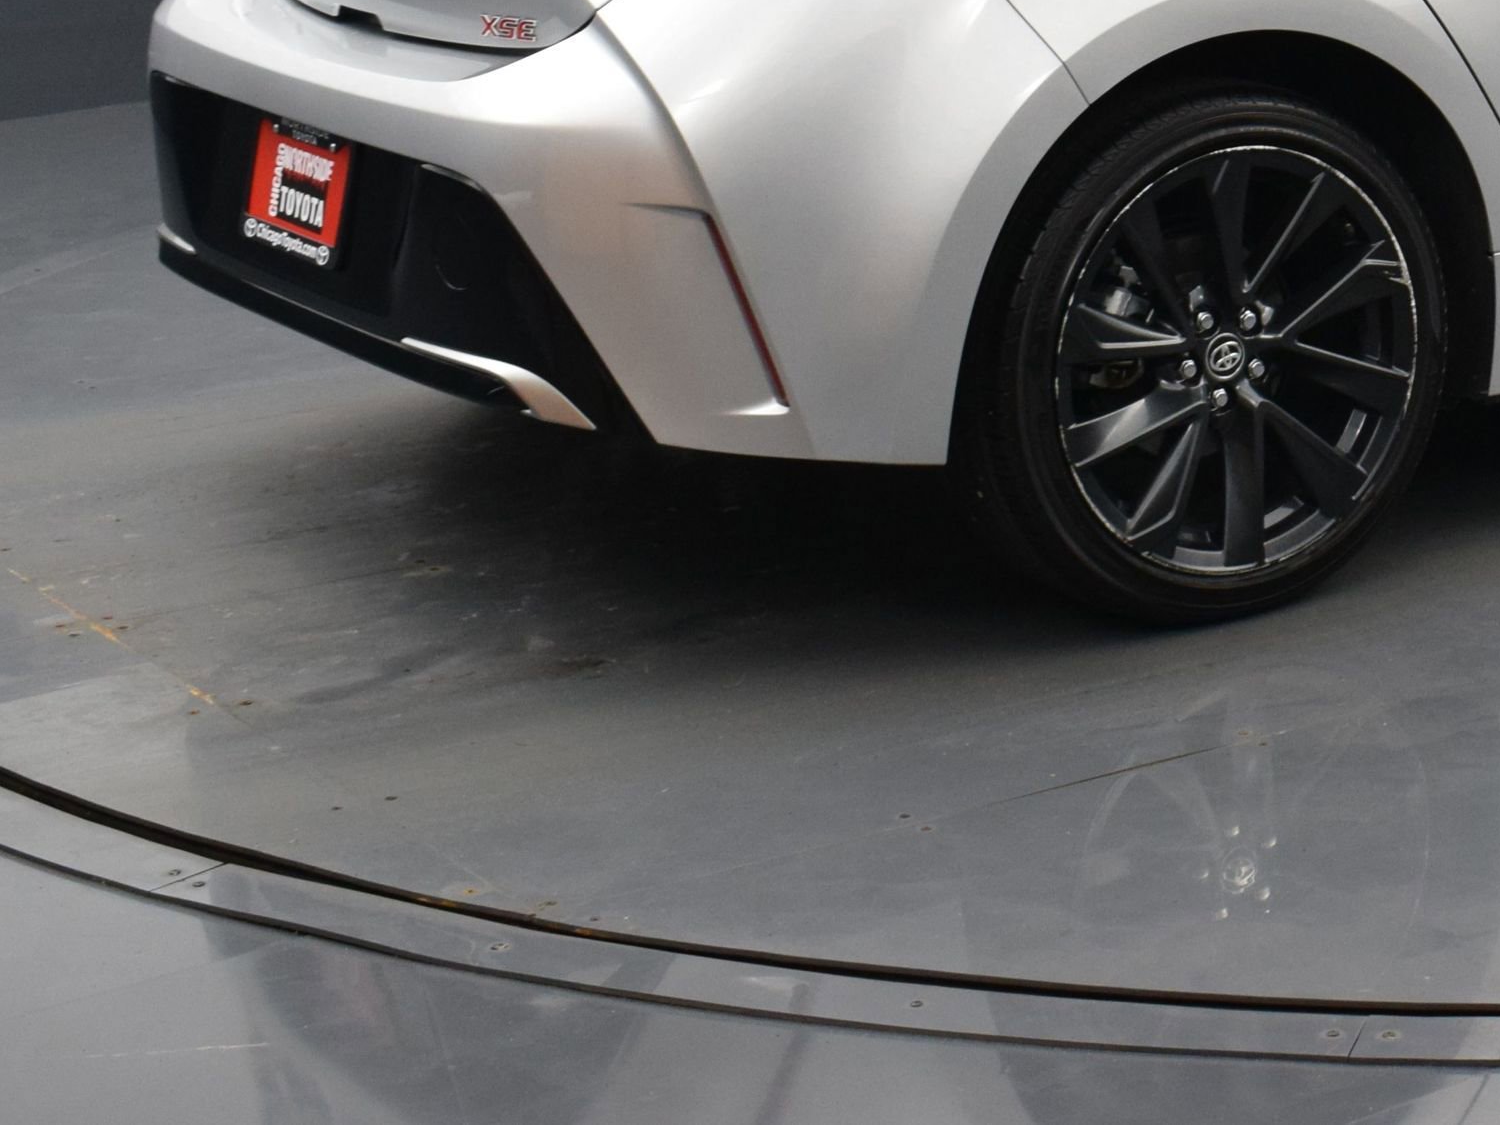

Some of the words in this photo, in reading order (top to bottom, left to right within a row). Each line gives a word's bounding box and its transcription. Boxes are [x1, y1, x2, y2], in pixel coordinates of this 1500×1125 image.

[480, 14, 537, 42] XSE
[268, 142, 286, 217] CHICAGO
[282, 143, 335, 182] NORTHSIDE
[279, 185, 324, 228] TOYOTA
